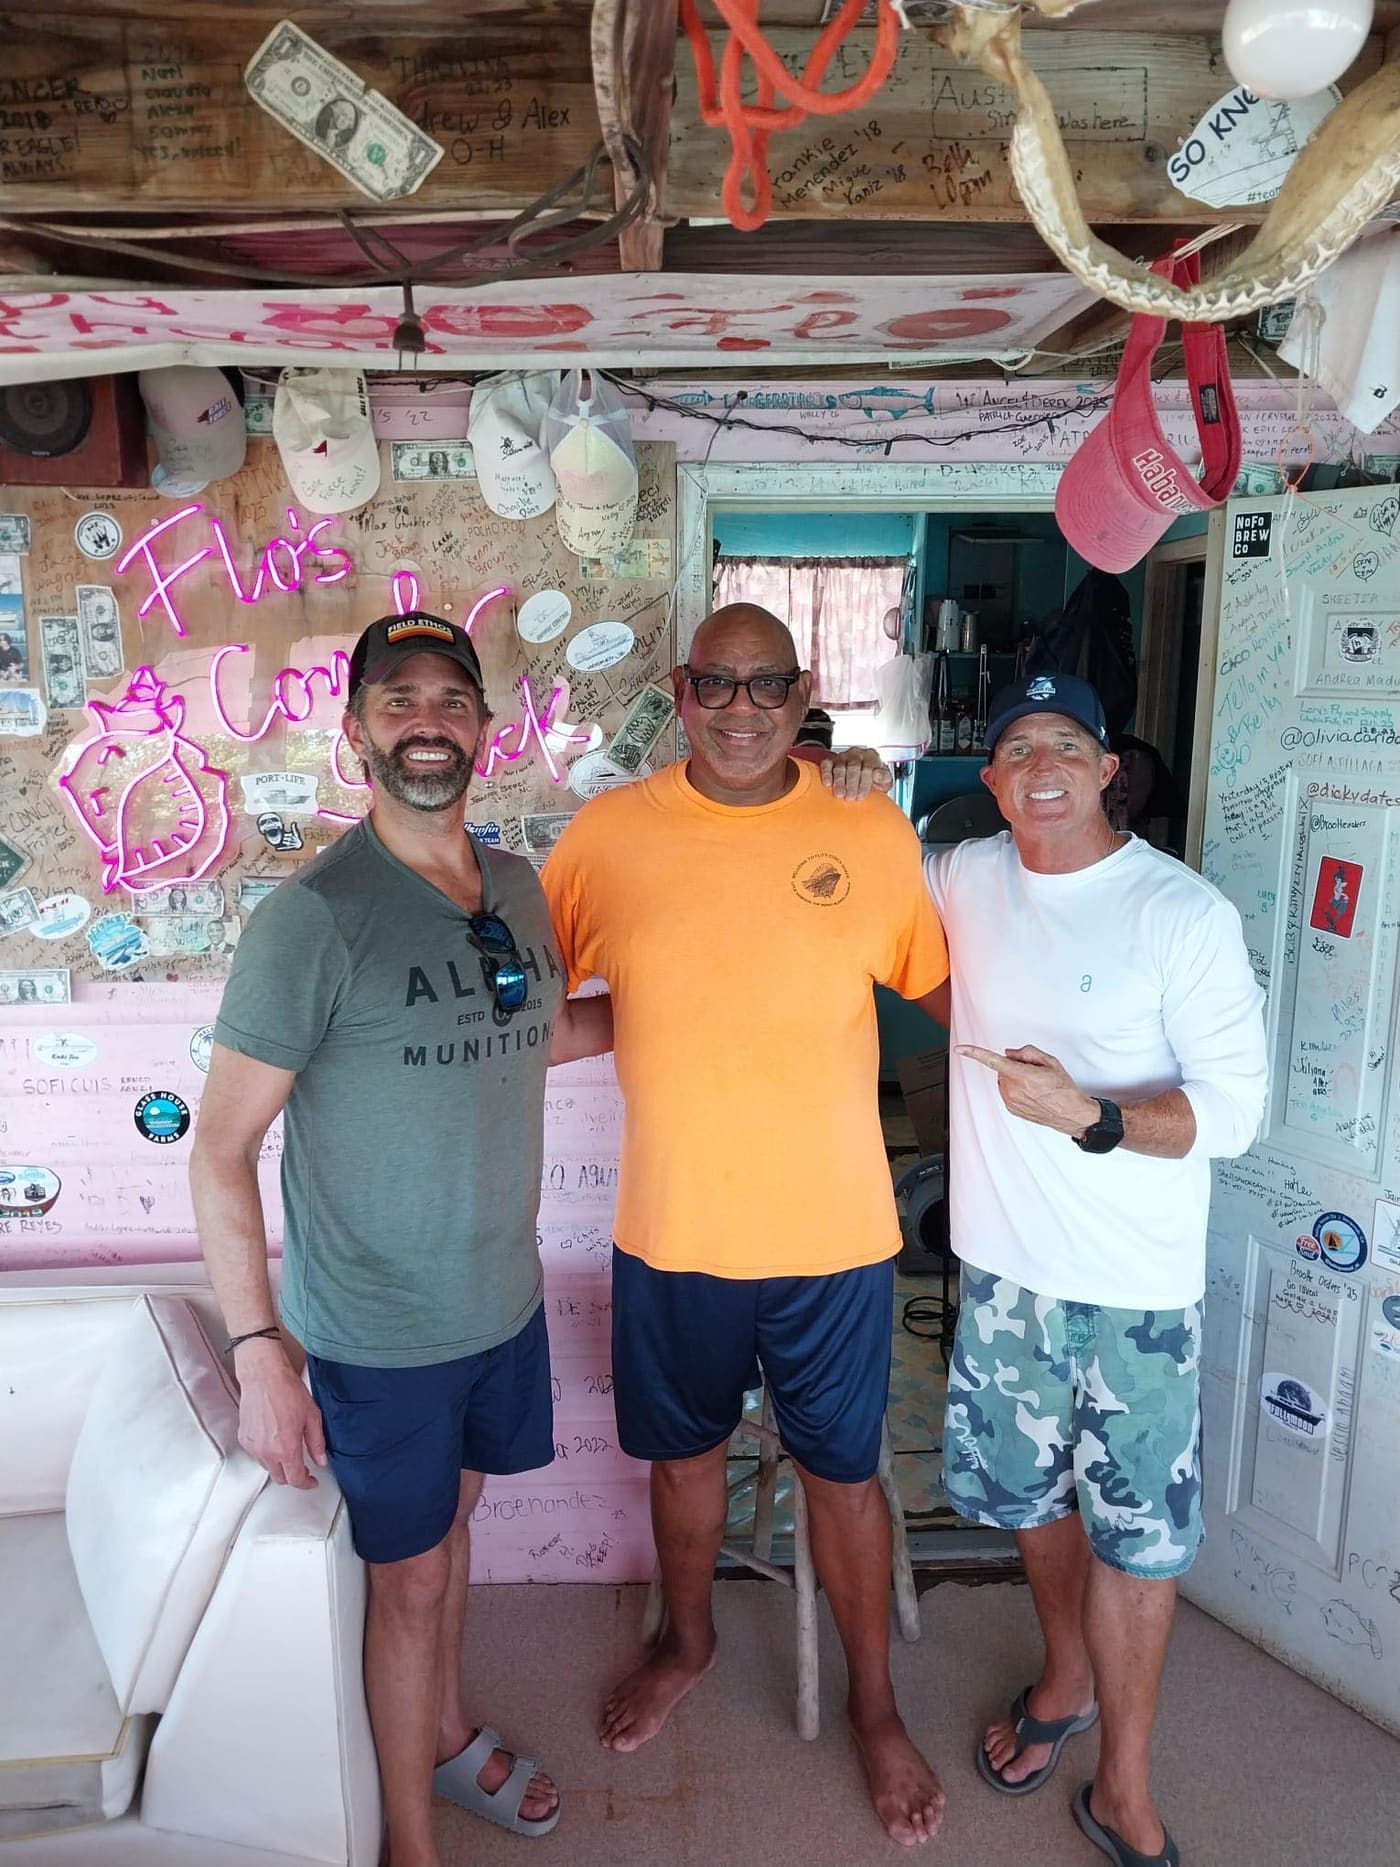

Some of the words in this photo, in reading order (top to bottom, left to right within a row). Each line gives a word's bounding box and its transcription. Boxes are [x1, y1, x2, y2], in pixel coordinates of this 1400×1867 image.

[771, 135, 835, 191] rankie
[1170, 138, 1206, 183] SO
[1235, 529, 1270, 543] BREW
[116, 504, 353, 637] Flo's
[387, 618, 417, 634] FIELD
[417, 618, 453, 634] ETHOS
[255, 773, 280, 785] PORT
[285, 773, 306, 785] LIFE
[457, 1009, 486, 1026] ESTD
[520, 998, 543, 1013] 2015
[403, 1021, 554, 1067] MUNITION
[22, 1078, 65, 1095] SOFI
[135, 1092, 157, 1118] GLASS
[160, 1091, 188, 1116] HOUSE
[148, 1132, 181, 1144] FARMS
[20, 1219, 64, 1234] REYES
